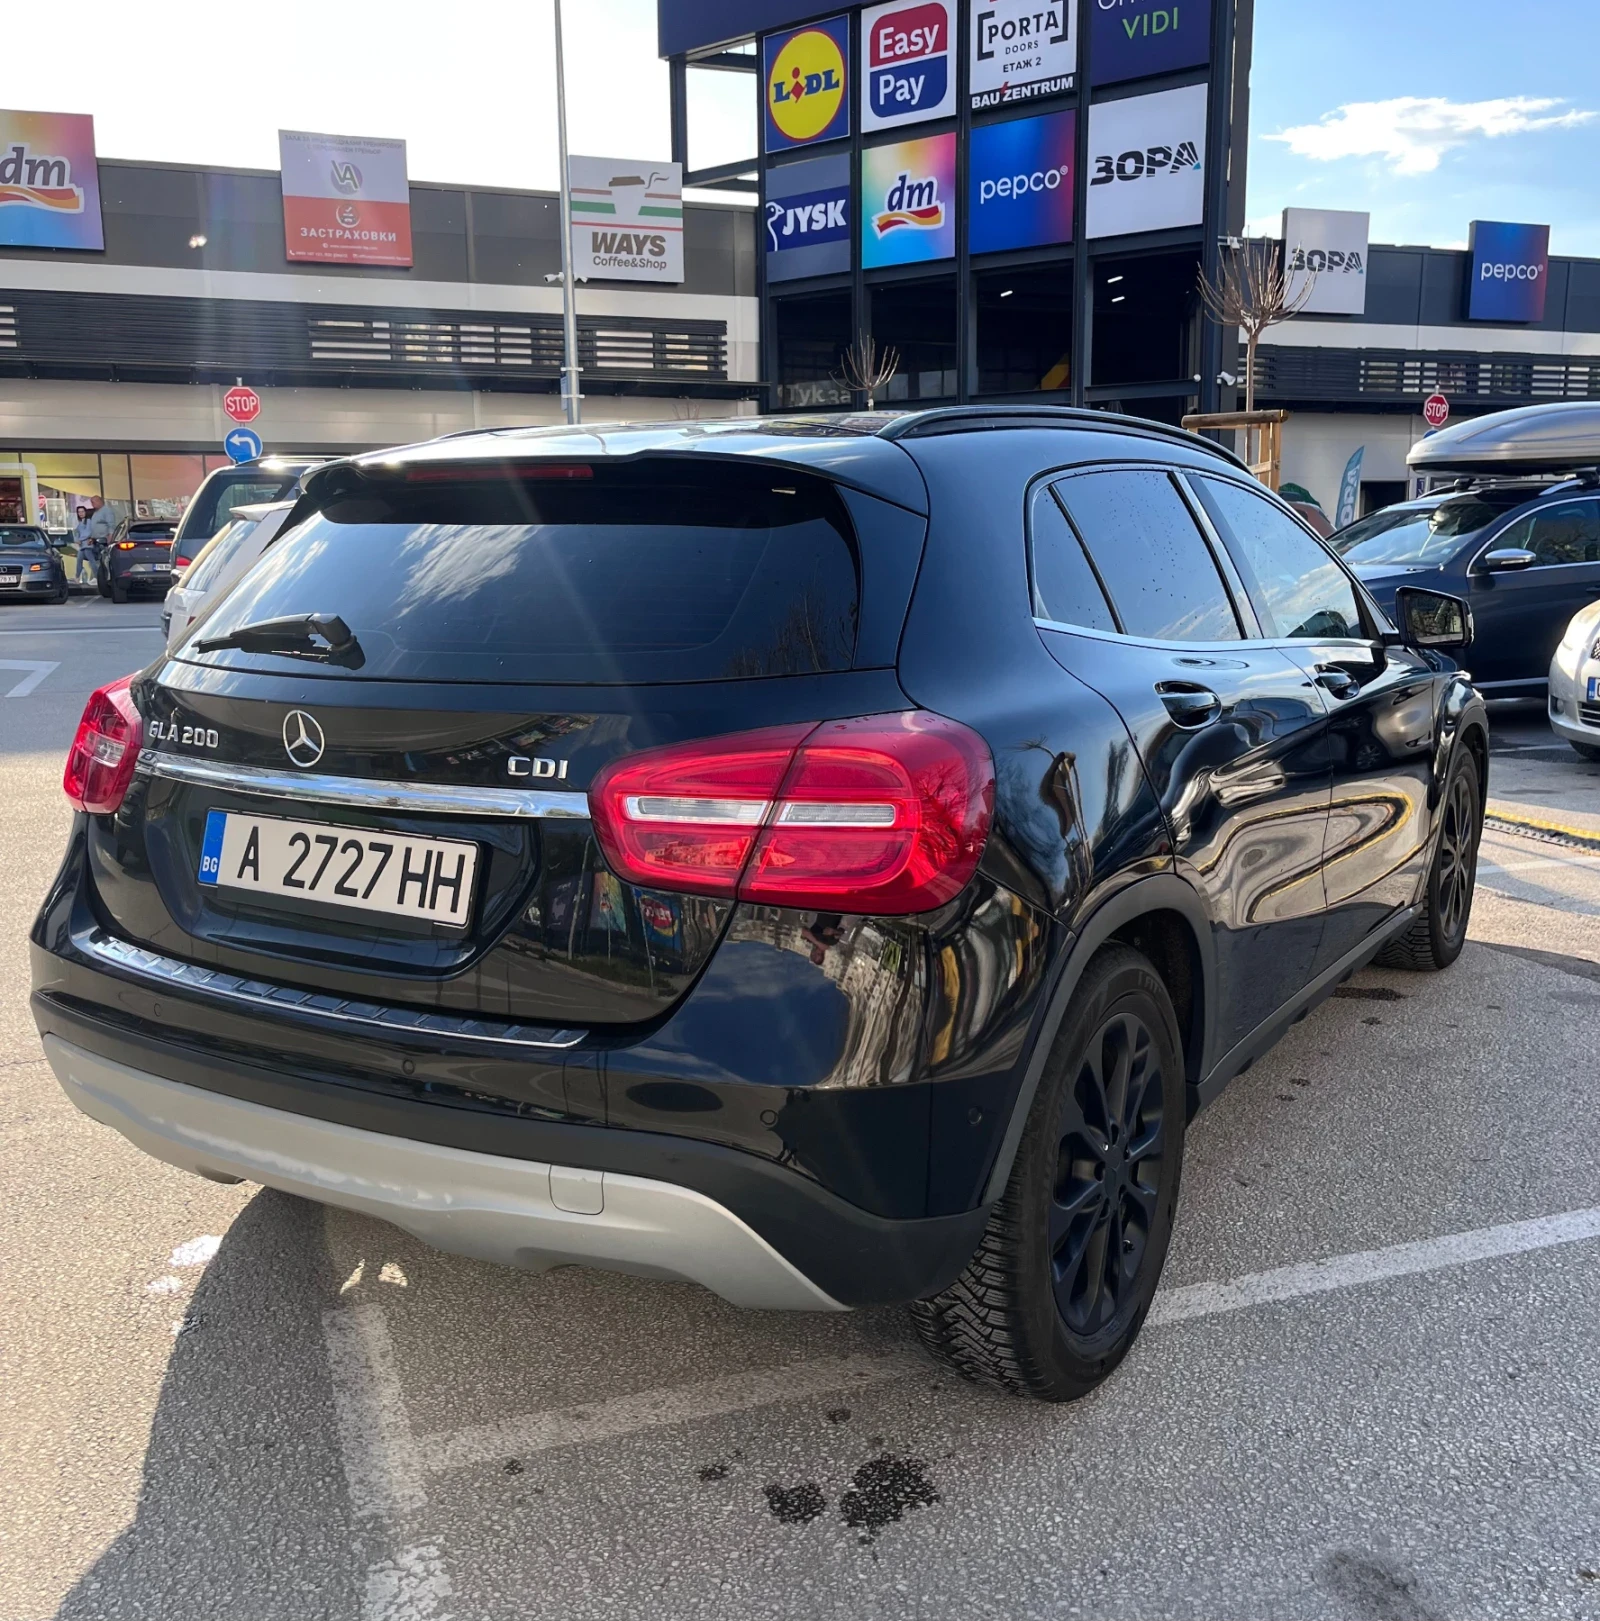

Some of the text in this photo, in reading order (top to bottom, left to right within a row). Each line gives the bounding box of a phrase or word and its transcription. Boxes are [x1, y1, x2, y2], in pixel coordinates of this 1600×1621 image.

[988, 11, 1060, 44] PORTA
[1122, 7, 1179, 40] VIDI
[880, 24, 939, 60] Easy
[1005, 41, 1039, 55] DOORS
[1002, 57, 1042, 73] ЕТАЖ 2
[880, 74, 926, 106] Pay
[0, 147, 65, 187] dm
[888, 175, 934, 212] dm
[980, 168, 1061, 204] pepco
[782, 199, 847, 236] JYSK
[300, 227, 397, 242] ЗАСТРАХОВКИ
[592, 231, 667, 257] WAYS
[593, 255, 667, 271] Coffee&Shop
[1480, 262, 1538, 282] pepco
[227, 396, 257, 412] STOP
[1426, 403, 1447, 418] STOP
[148, 720, 219, 748] GLA 200
[508, 755, 569, 779] CDI
[202, 855, 218, 873] BG
[237, 826, 259, 881] A
[283, 832, 393, 899] 2727
